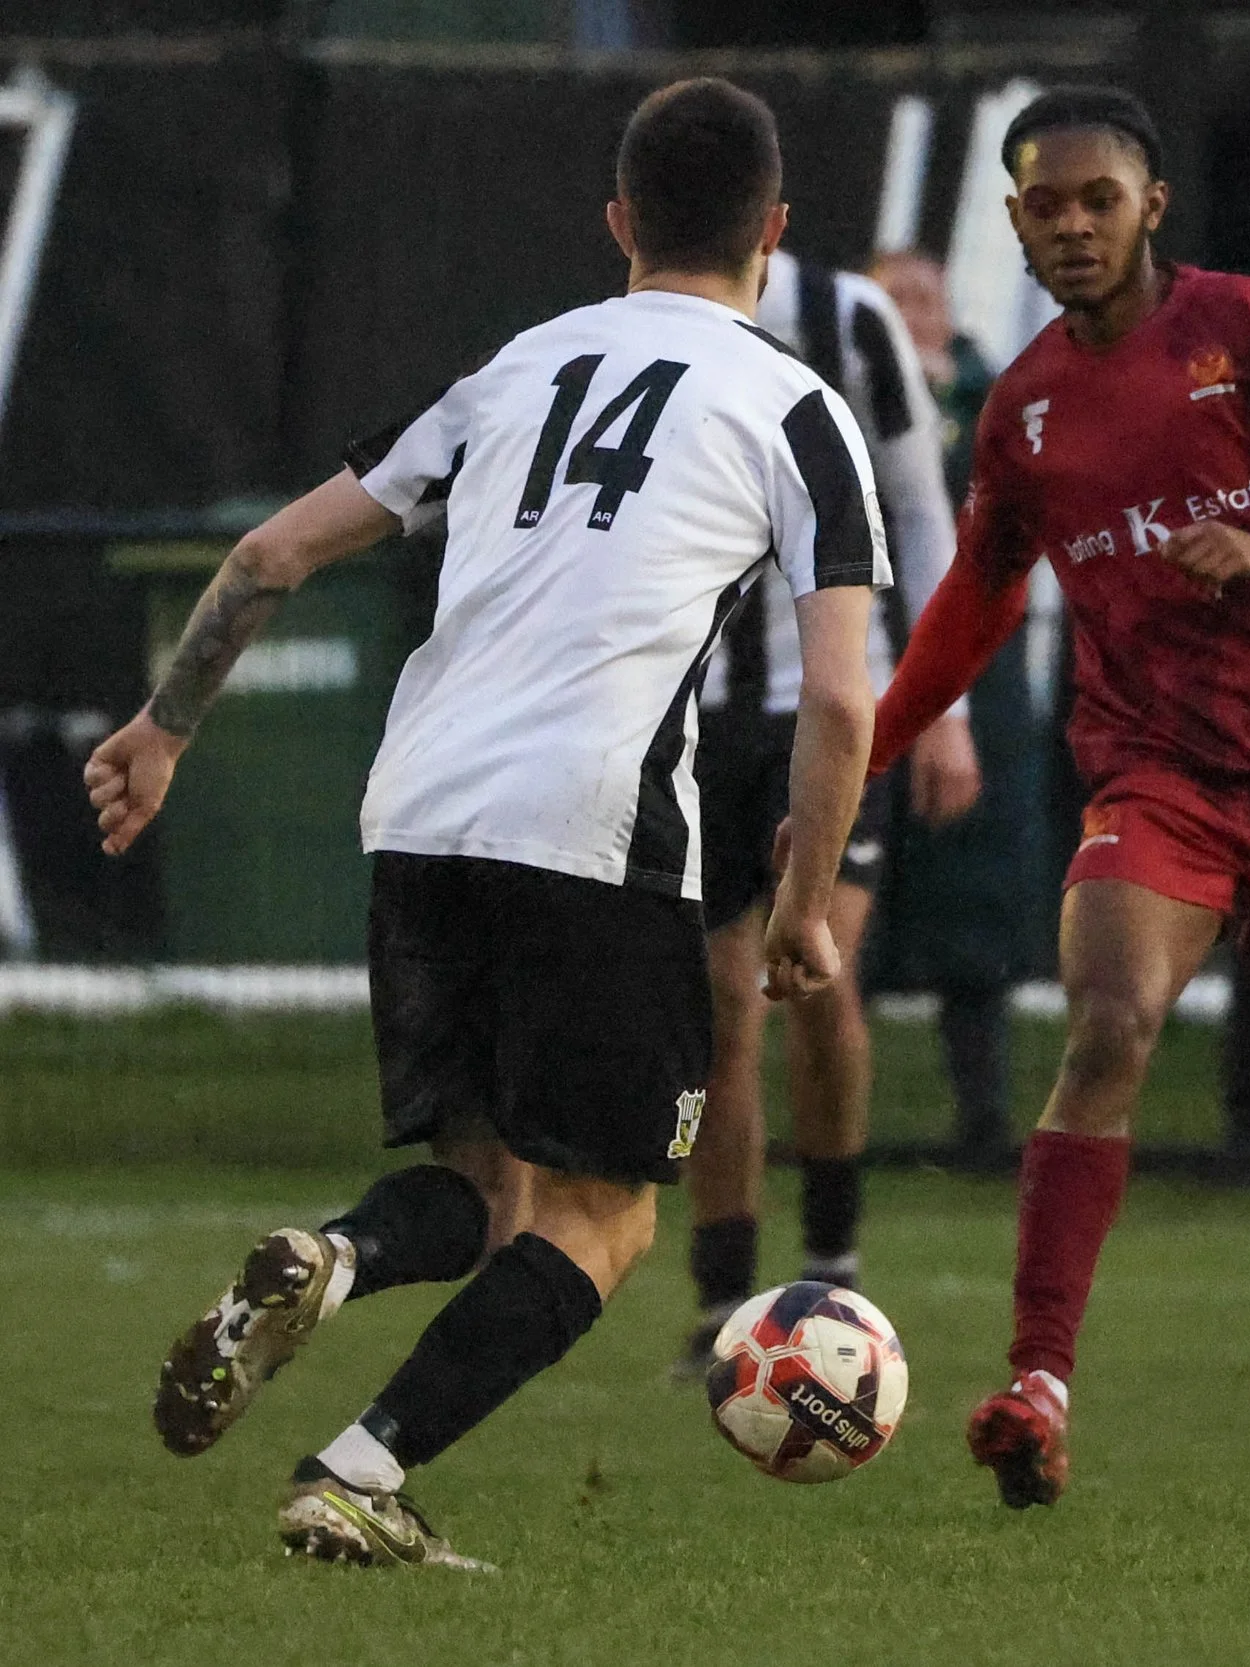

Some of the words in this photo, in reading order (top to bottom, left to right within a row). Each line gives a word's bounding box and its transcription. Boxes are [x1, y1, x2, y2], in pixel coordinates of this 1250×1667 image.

[513, 354, 691, 532] 14
[520, 510, 540, 522] AR
[592, 511, 612, 524] AR
[1123, 498, 1172, 557] K
[790, 1383, 871, 1449] uhlsport
